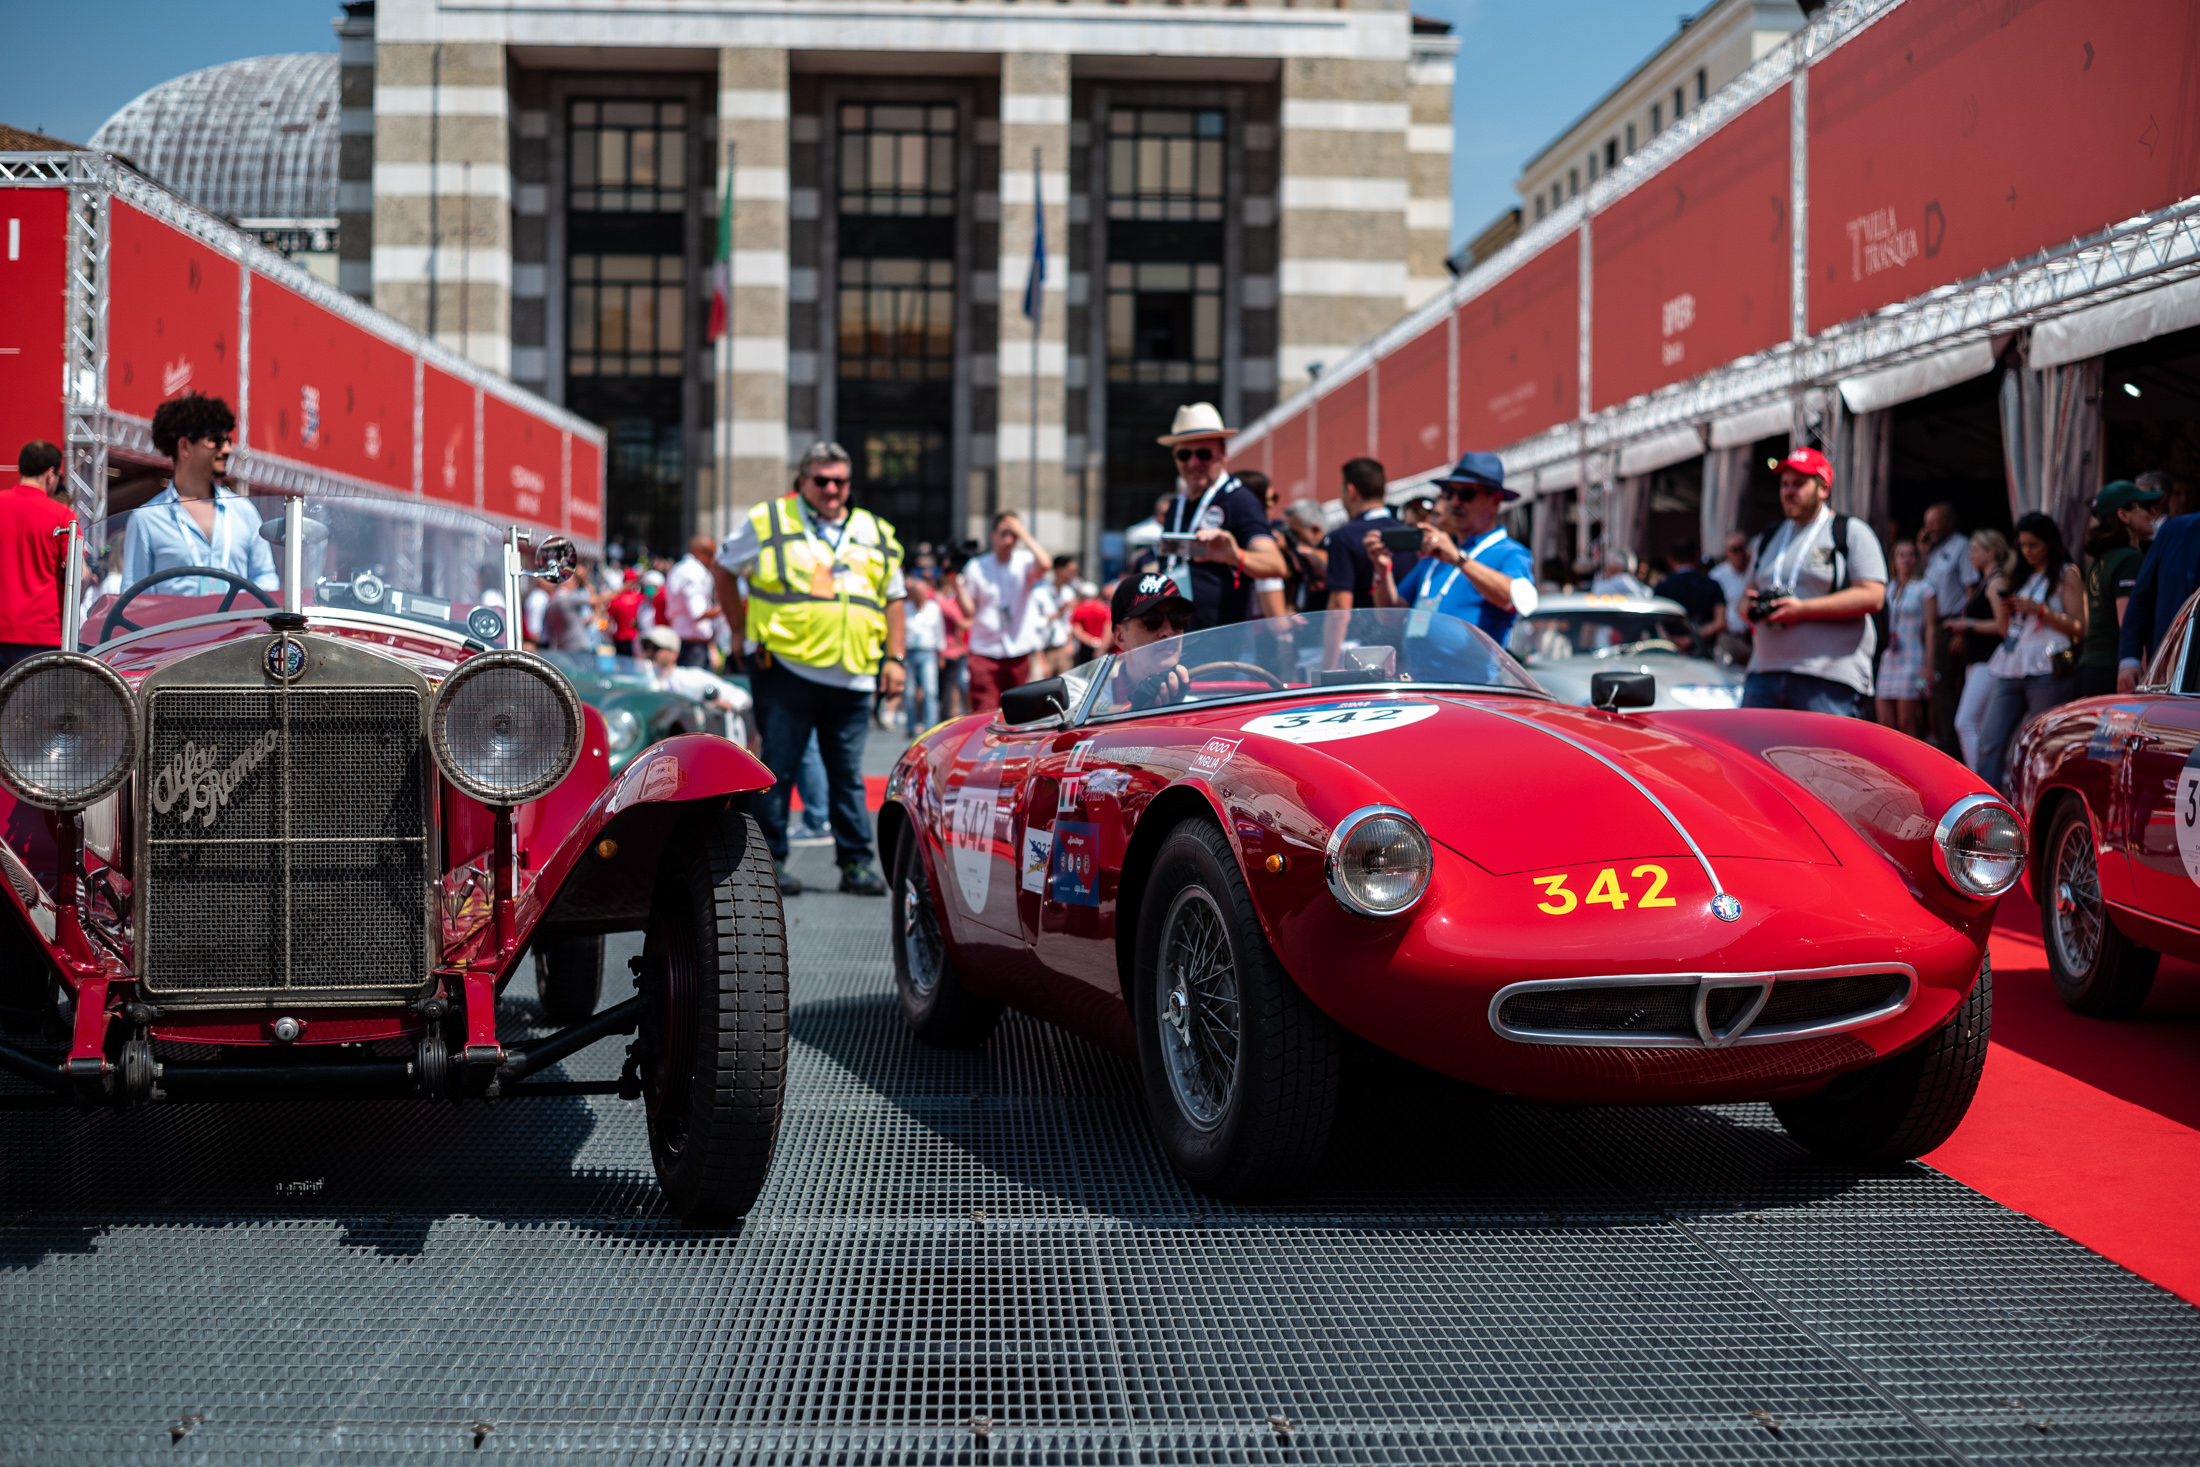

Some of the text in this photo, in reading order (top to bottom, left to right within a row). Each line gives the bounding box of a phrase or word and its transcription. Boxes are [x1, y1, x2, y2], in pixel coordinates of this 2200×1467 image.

[1273, 709, 1403, 729] 342
[1195, 754, 1220, 769] MIGLIA
[1207, 741, 1230, 754] 1000
[153, 740, 218, 823] Alfa
[193, 729, 279, 828] Romeo
[2185, 779, 2200, 828] 3
[959, 799, 989, 853] 342
[1532, 864, 1677, 916] 342
